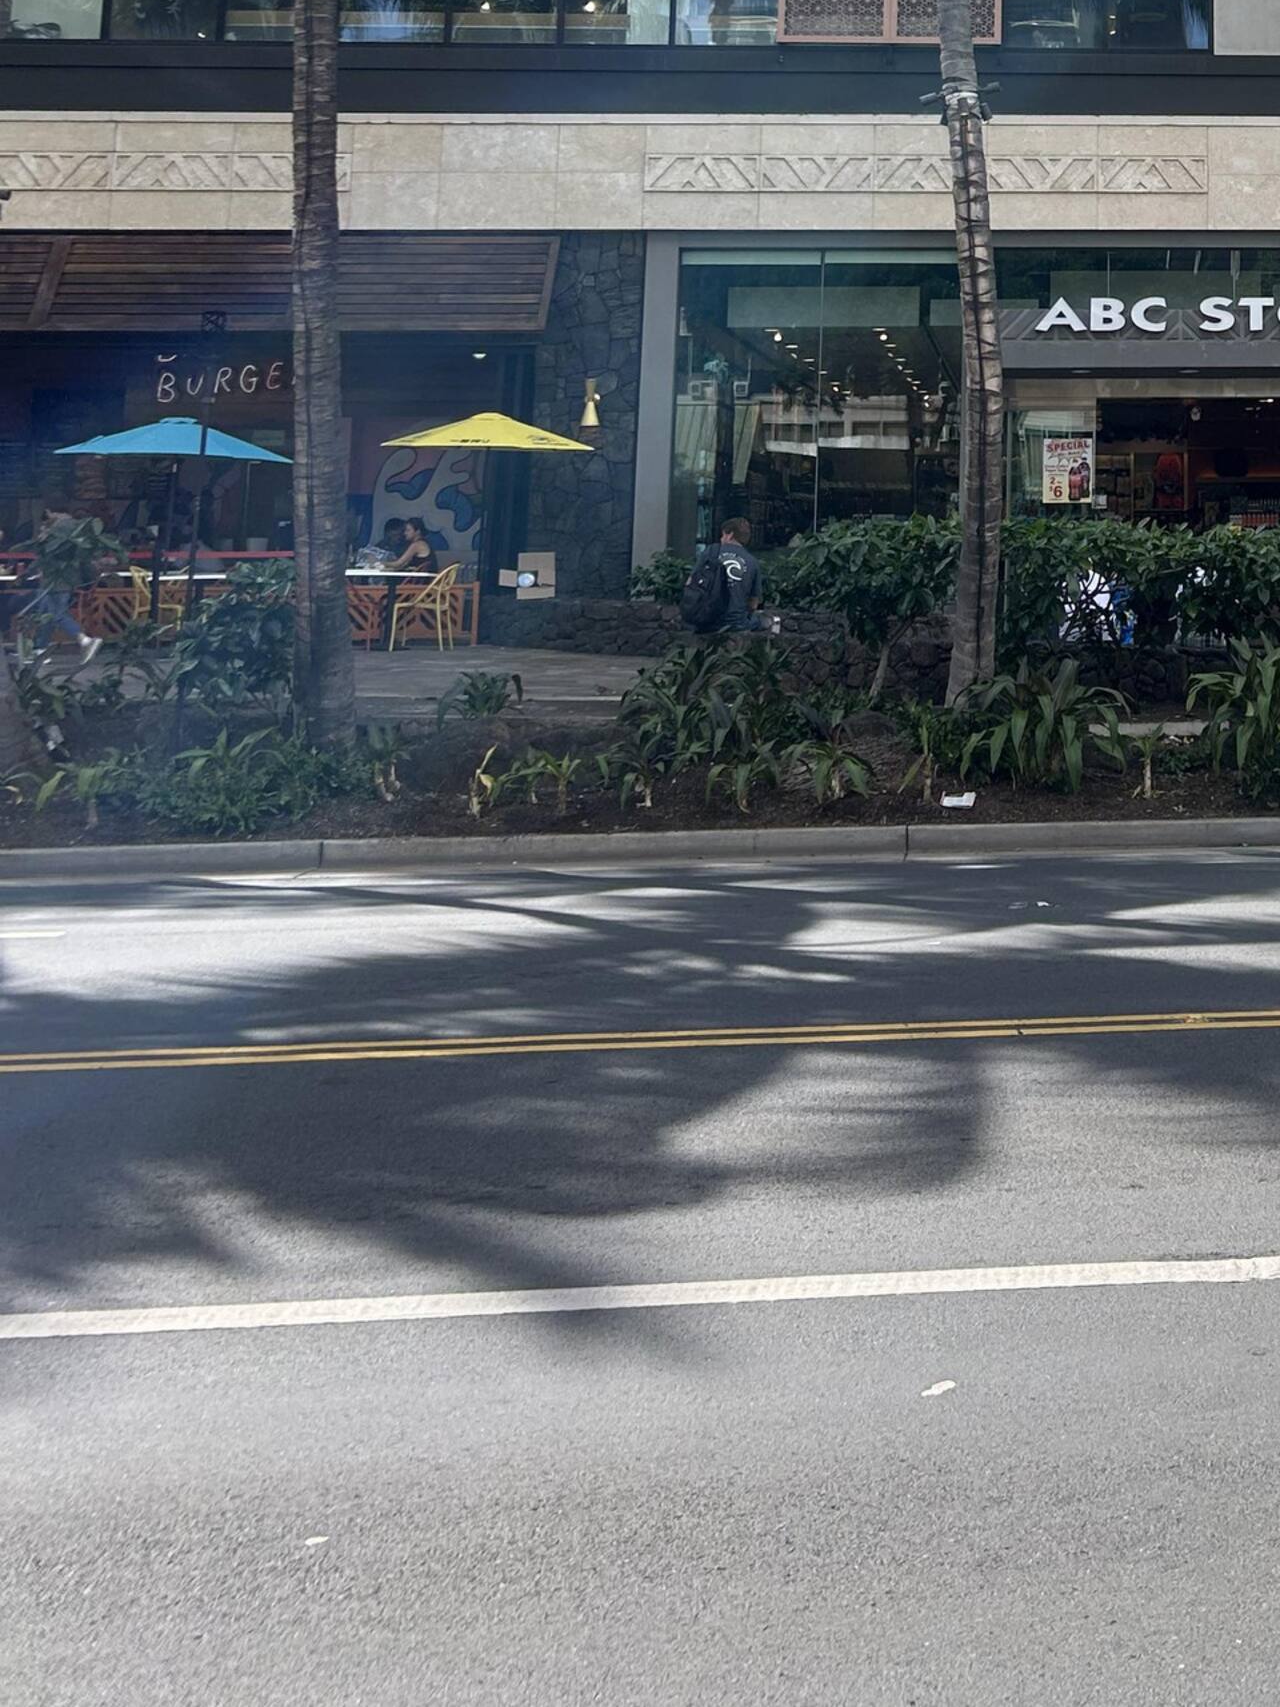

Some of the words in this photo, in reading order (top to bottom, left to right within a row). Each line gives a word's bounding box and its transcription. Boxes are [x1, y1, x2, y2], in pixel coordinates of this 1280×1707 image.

[1034, 296, 1168, 332] ABC
[157, 361, 297, 403] BURGE
[1047, 440, 1090, 452] SPECIAL
[1049, 476, 1056, 484] 2
